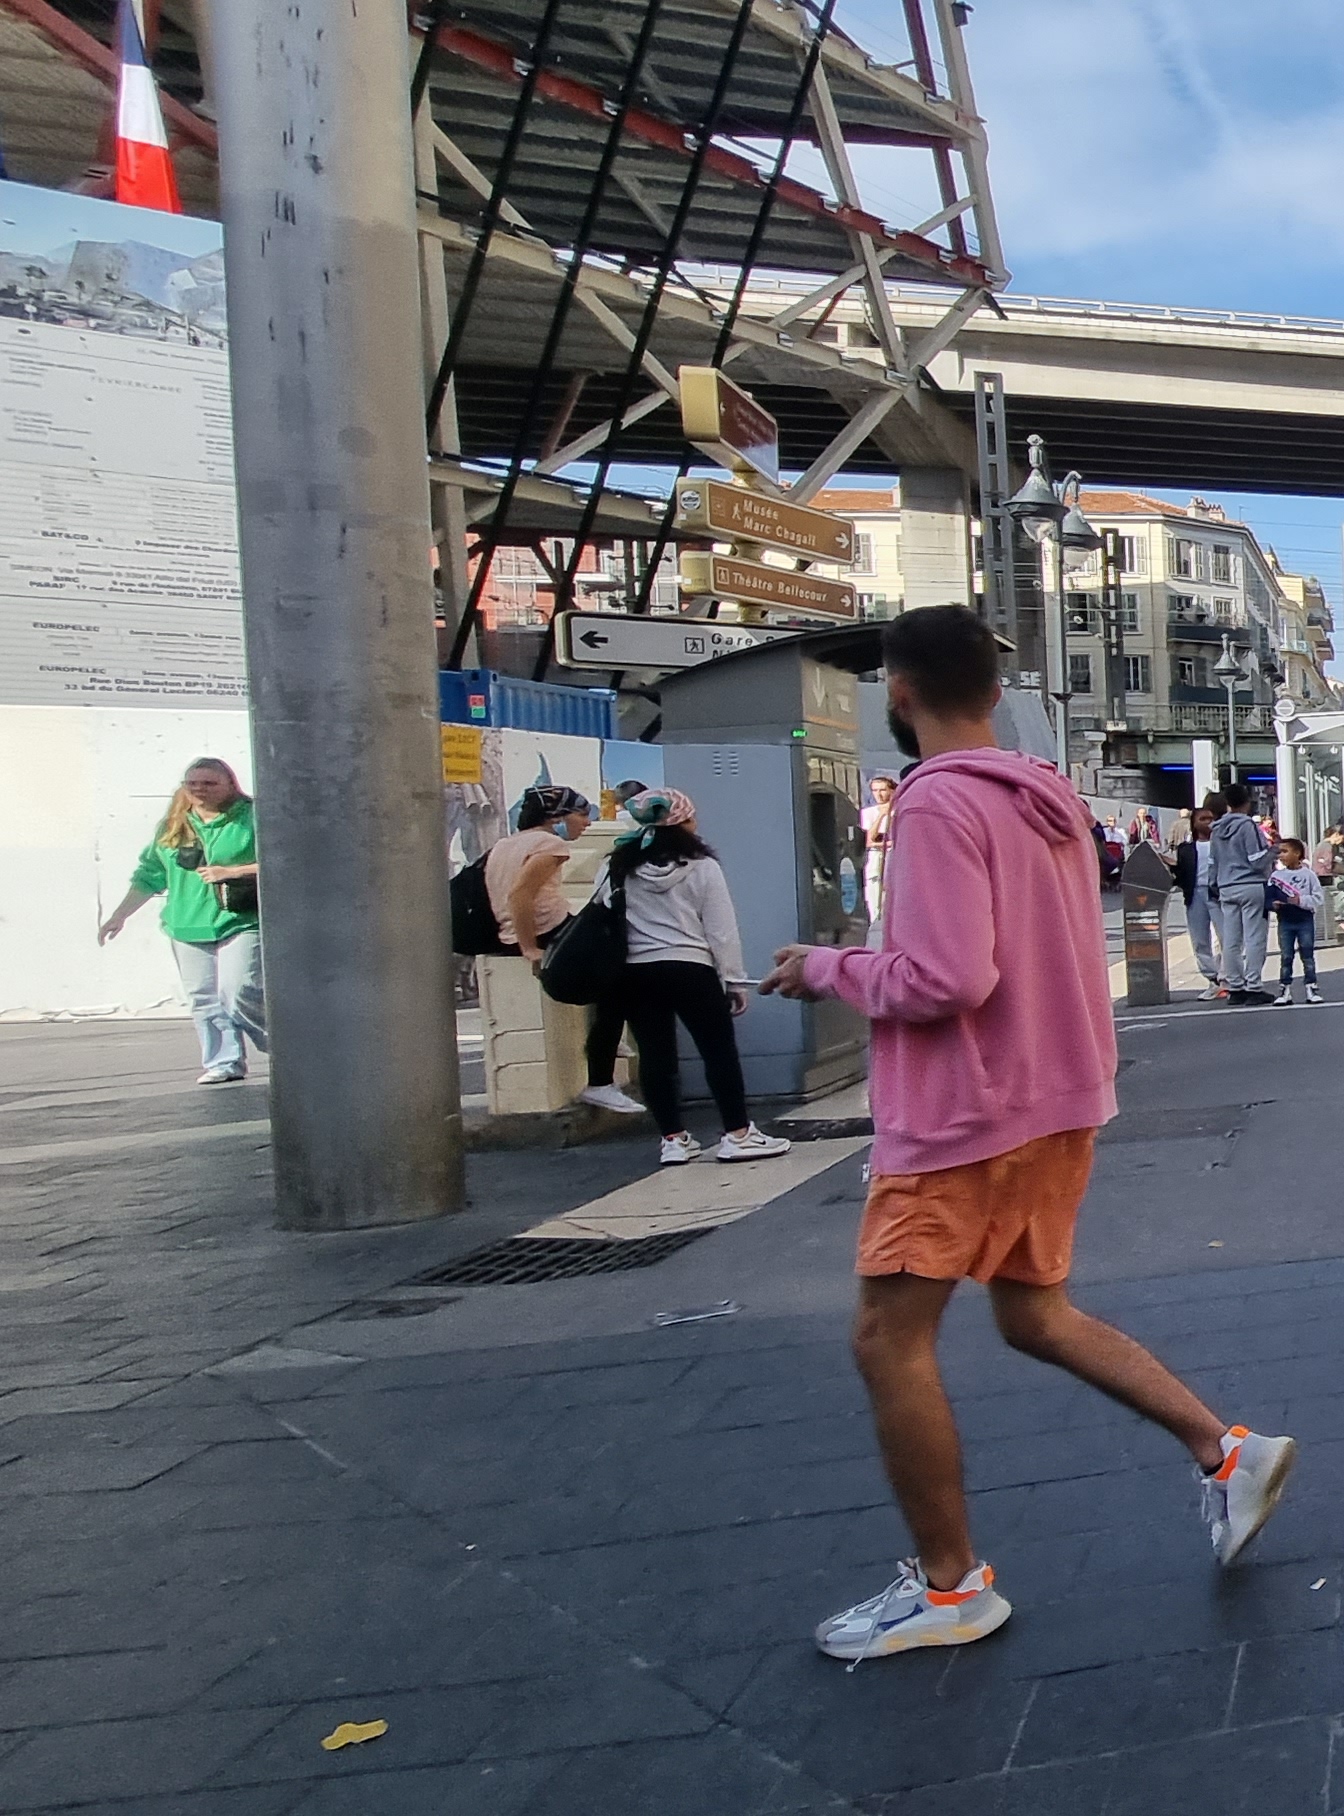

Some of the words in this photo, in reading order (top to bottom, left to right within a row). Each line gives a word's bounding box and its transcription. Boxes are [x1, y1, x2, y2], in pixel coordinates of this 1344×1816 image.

[743, 500, 779, 521] Musée
[743, 517, 771, 536] Marc
[776, 525, 817, 547] Chagall
[732, 572, 774, 592] Théâtre
[777, 581, 827, 602] Bellecour
[33, 622, 100, 632] EUROPELEC
[711, 632, 753, 647] Gare
[39, 665, 106, 674] EUROPELEC
